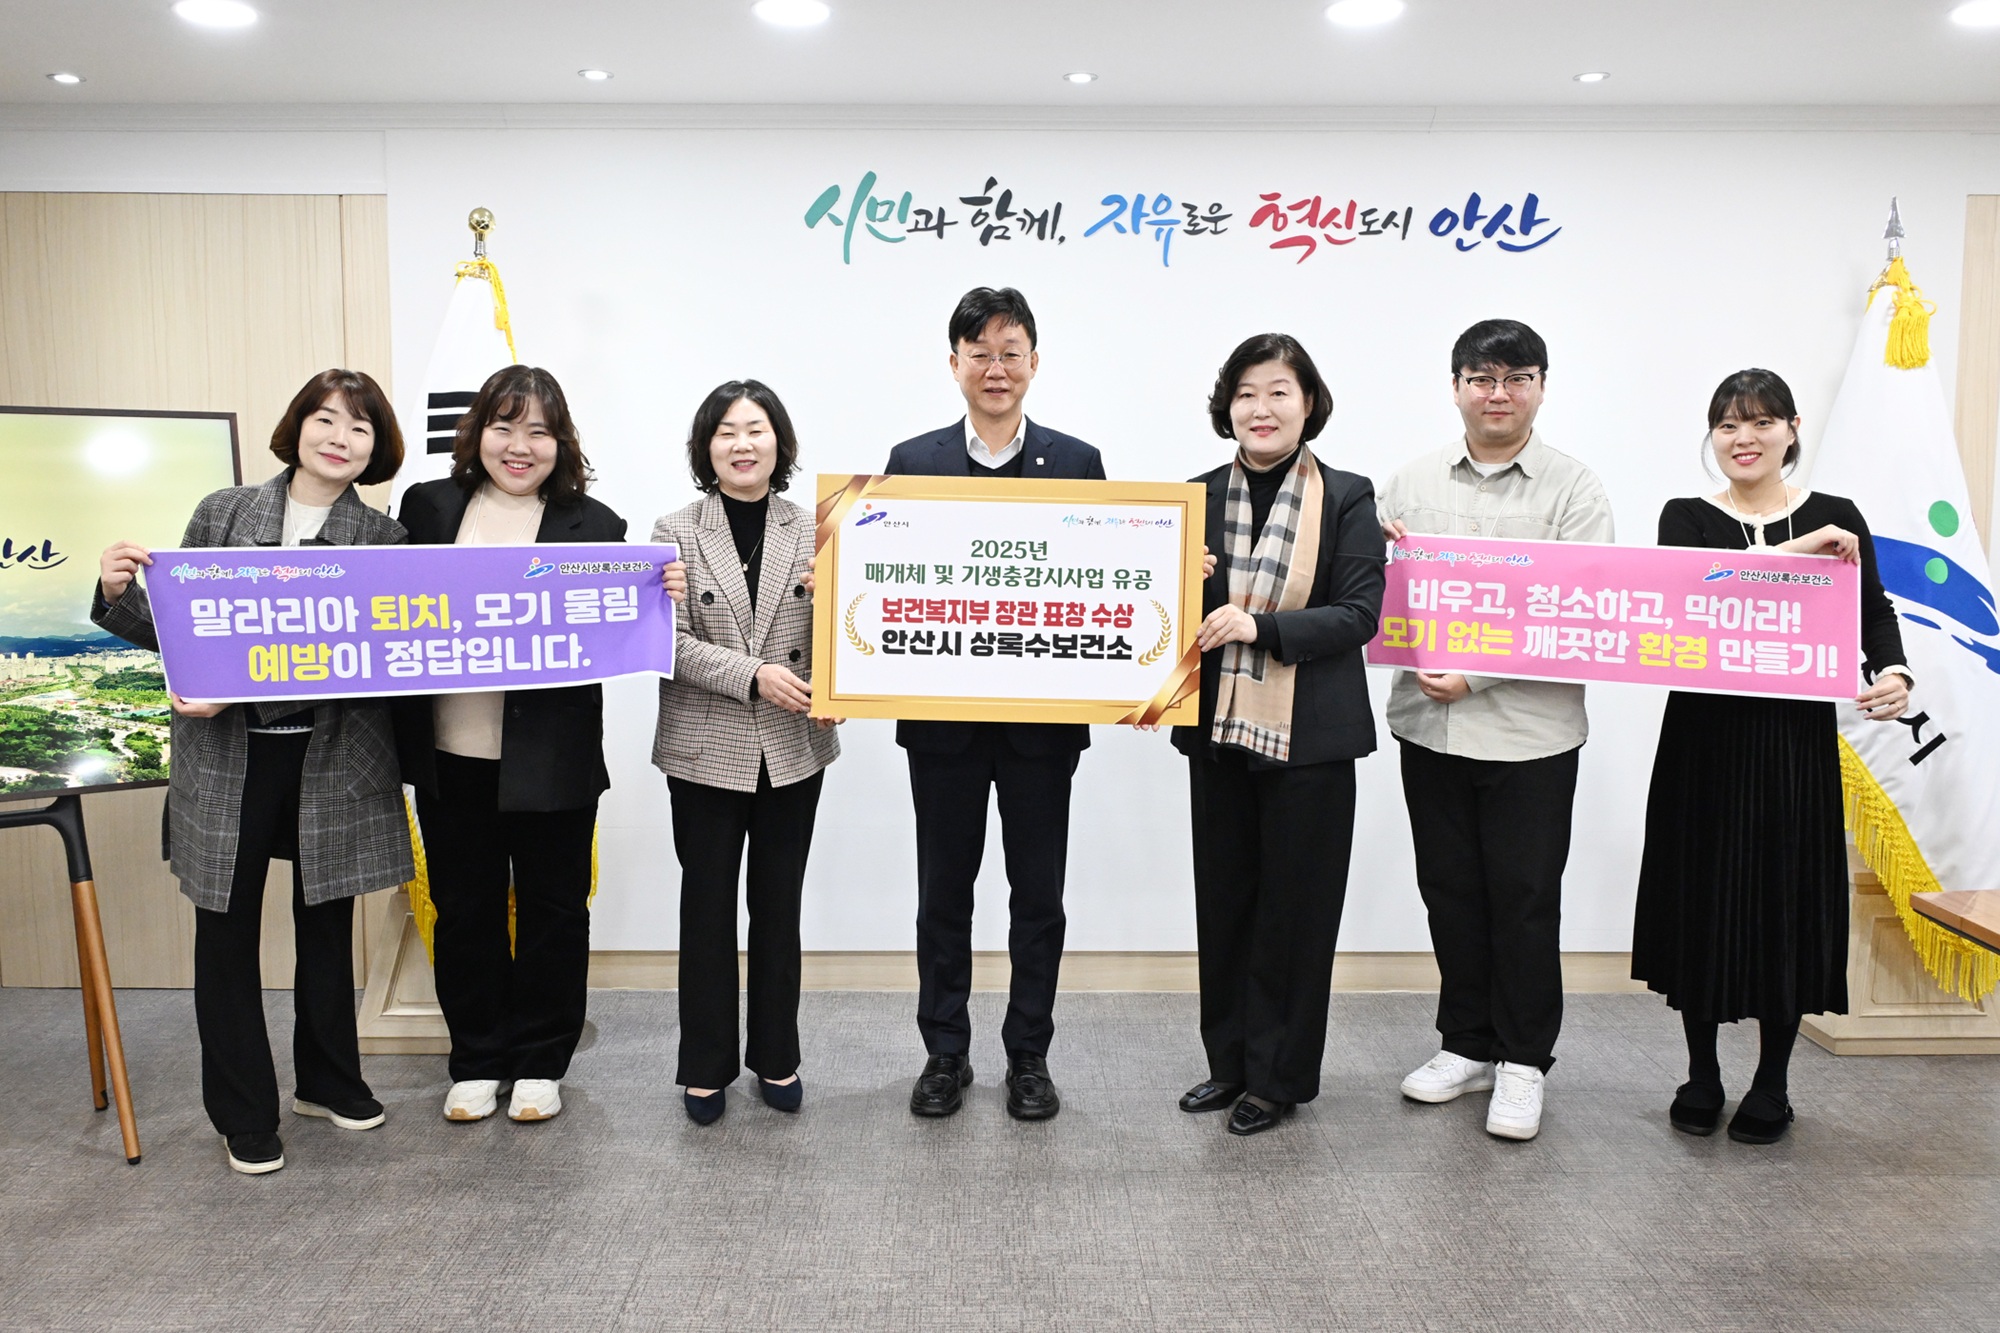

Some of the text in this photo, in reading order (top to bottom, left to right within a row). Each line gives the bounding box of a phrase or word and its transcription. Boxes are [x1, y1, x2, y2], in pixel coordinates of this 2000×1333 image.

[804, 170, 1562, 267] 시민과 함께, 자유로운 혁신도시 안산
[970, 539, 1049, 561] 2025년
[1505, 554, 1534, 566] 안산
[272, 565, 311, 582] 혁신도시
[313, 565, 345, 578] 안산
[560, 561, 652, 575] 안산시상록수보건소
[864, 562, 1153, 591] 매개체 및 기생충감시사업 유공
[1740, 570, 1832, 586] 안산시상록수보건소
[191, 585, 638, 637] 말라리아 퇴치, 모기 물림
[881, 597, 1134, 629] 보건복지부 장관 표창 수상
[1408, 578, 1801, 634] 비우고, 청소하고, 막아라!
[249, 633, 592, 682] 예방이 정답입니다.
[881, 629, 1133, 661] 안산시 상록수보건소
[1382, 617, 1838, 678] 모기 없는 깨끗한 환경 만들기!
